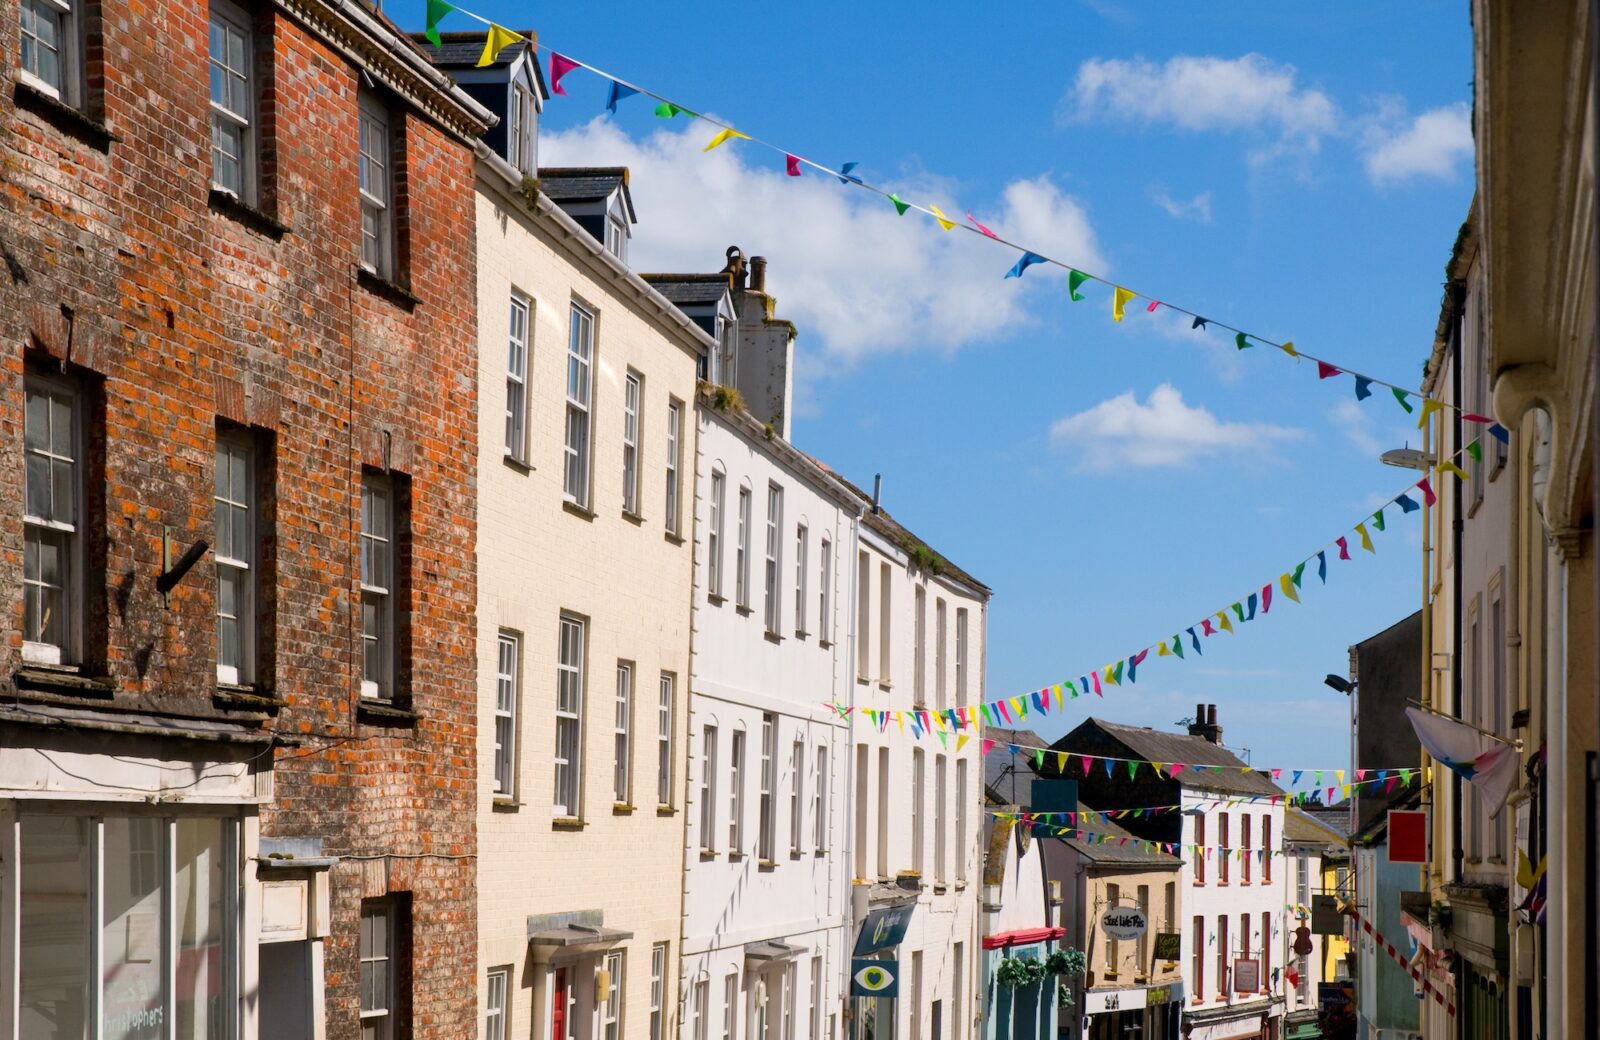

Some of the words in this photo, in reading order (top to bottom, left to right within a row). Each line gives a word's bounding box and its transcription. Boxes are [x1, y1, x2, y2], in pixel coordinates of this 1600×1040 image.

[1104, 914, 1118, 926] Just
[1119, 915, 1131, 927] Like
[1130, 914, 1144, 928] This
[1159, 935, 1179, 946] Kerry
[104, 1005, 163, 1032] hristophers
